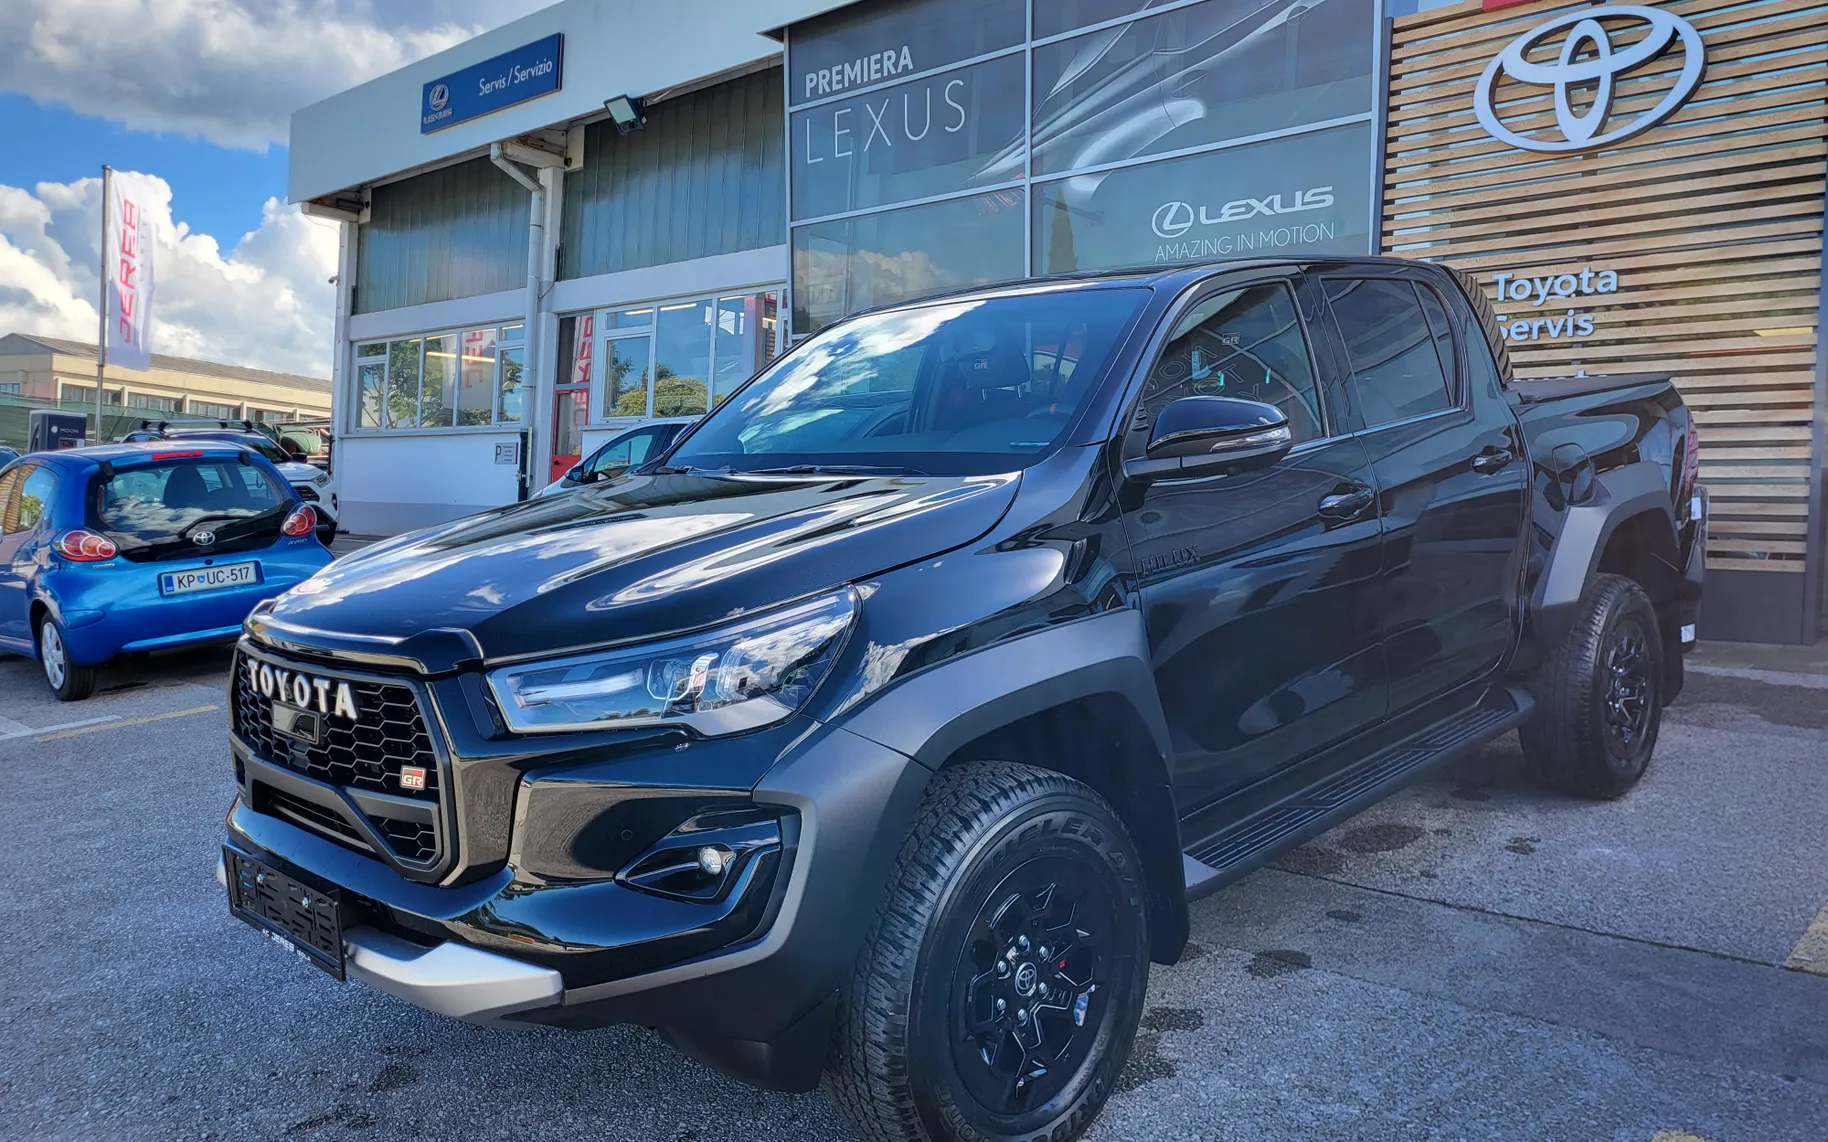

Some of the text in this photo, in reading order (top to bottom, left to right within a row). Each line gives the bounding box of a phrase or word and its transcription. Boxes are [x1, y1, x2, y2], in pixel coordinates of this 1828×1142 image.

[479, 75, 506, 96] Servis
[513, 58, 553, 84] Servizio
[805, 45, 914, 98] PREMIERA
[423, 108, 453, 124] LEXUS
[806, 79, 966, 164] LEXUS
[1200, 186, 1335, 225] LEXUS
[1154, 222, 1335, 263] AMAZING IN MOTION
[119, 199, 137, 344] JEREB
[1491, 266, 1619, 307] Toyota
[177, 566, 250, 589] KP UC-517
[247, 659, 358, 720] TOYOTA
[403, 774, 423, 788] GR
[271, 931, 295, 954] JEREB
